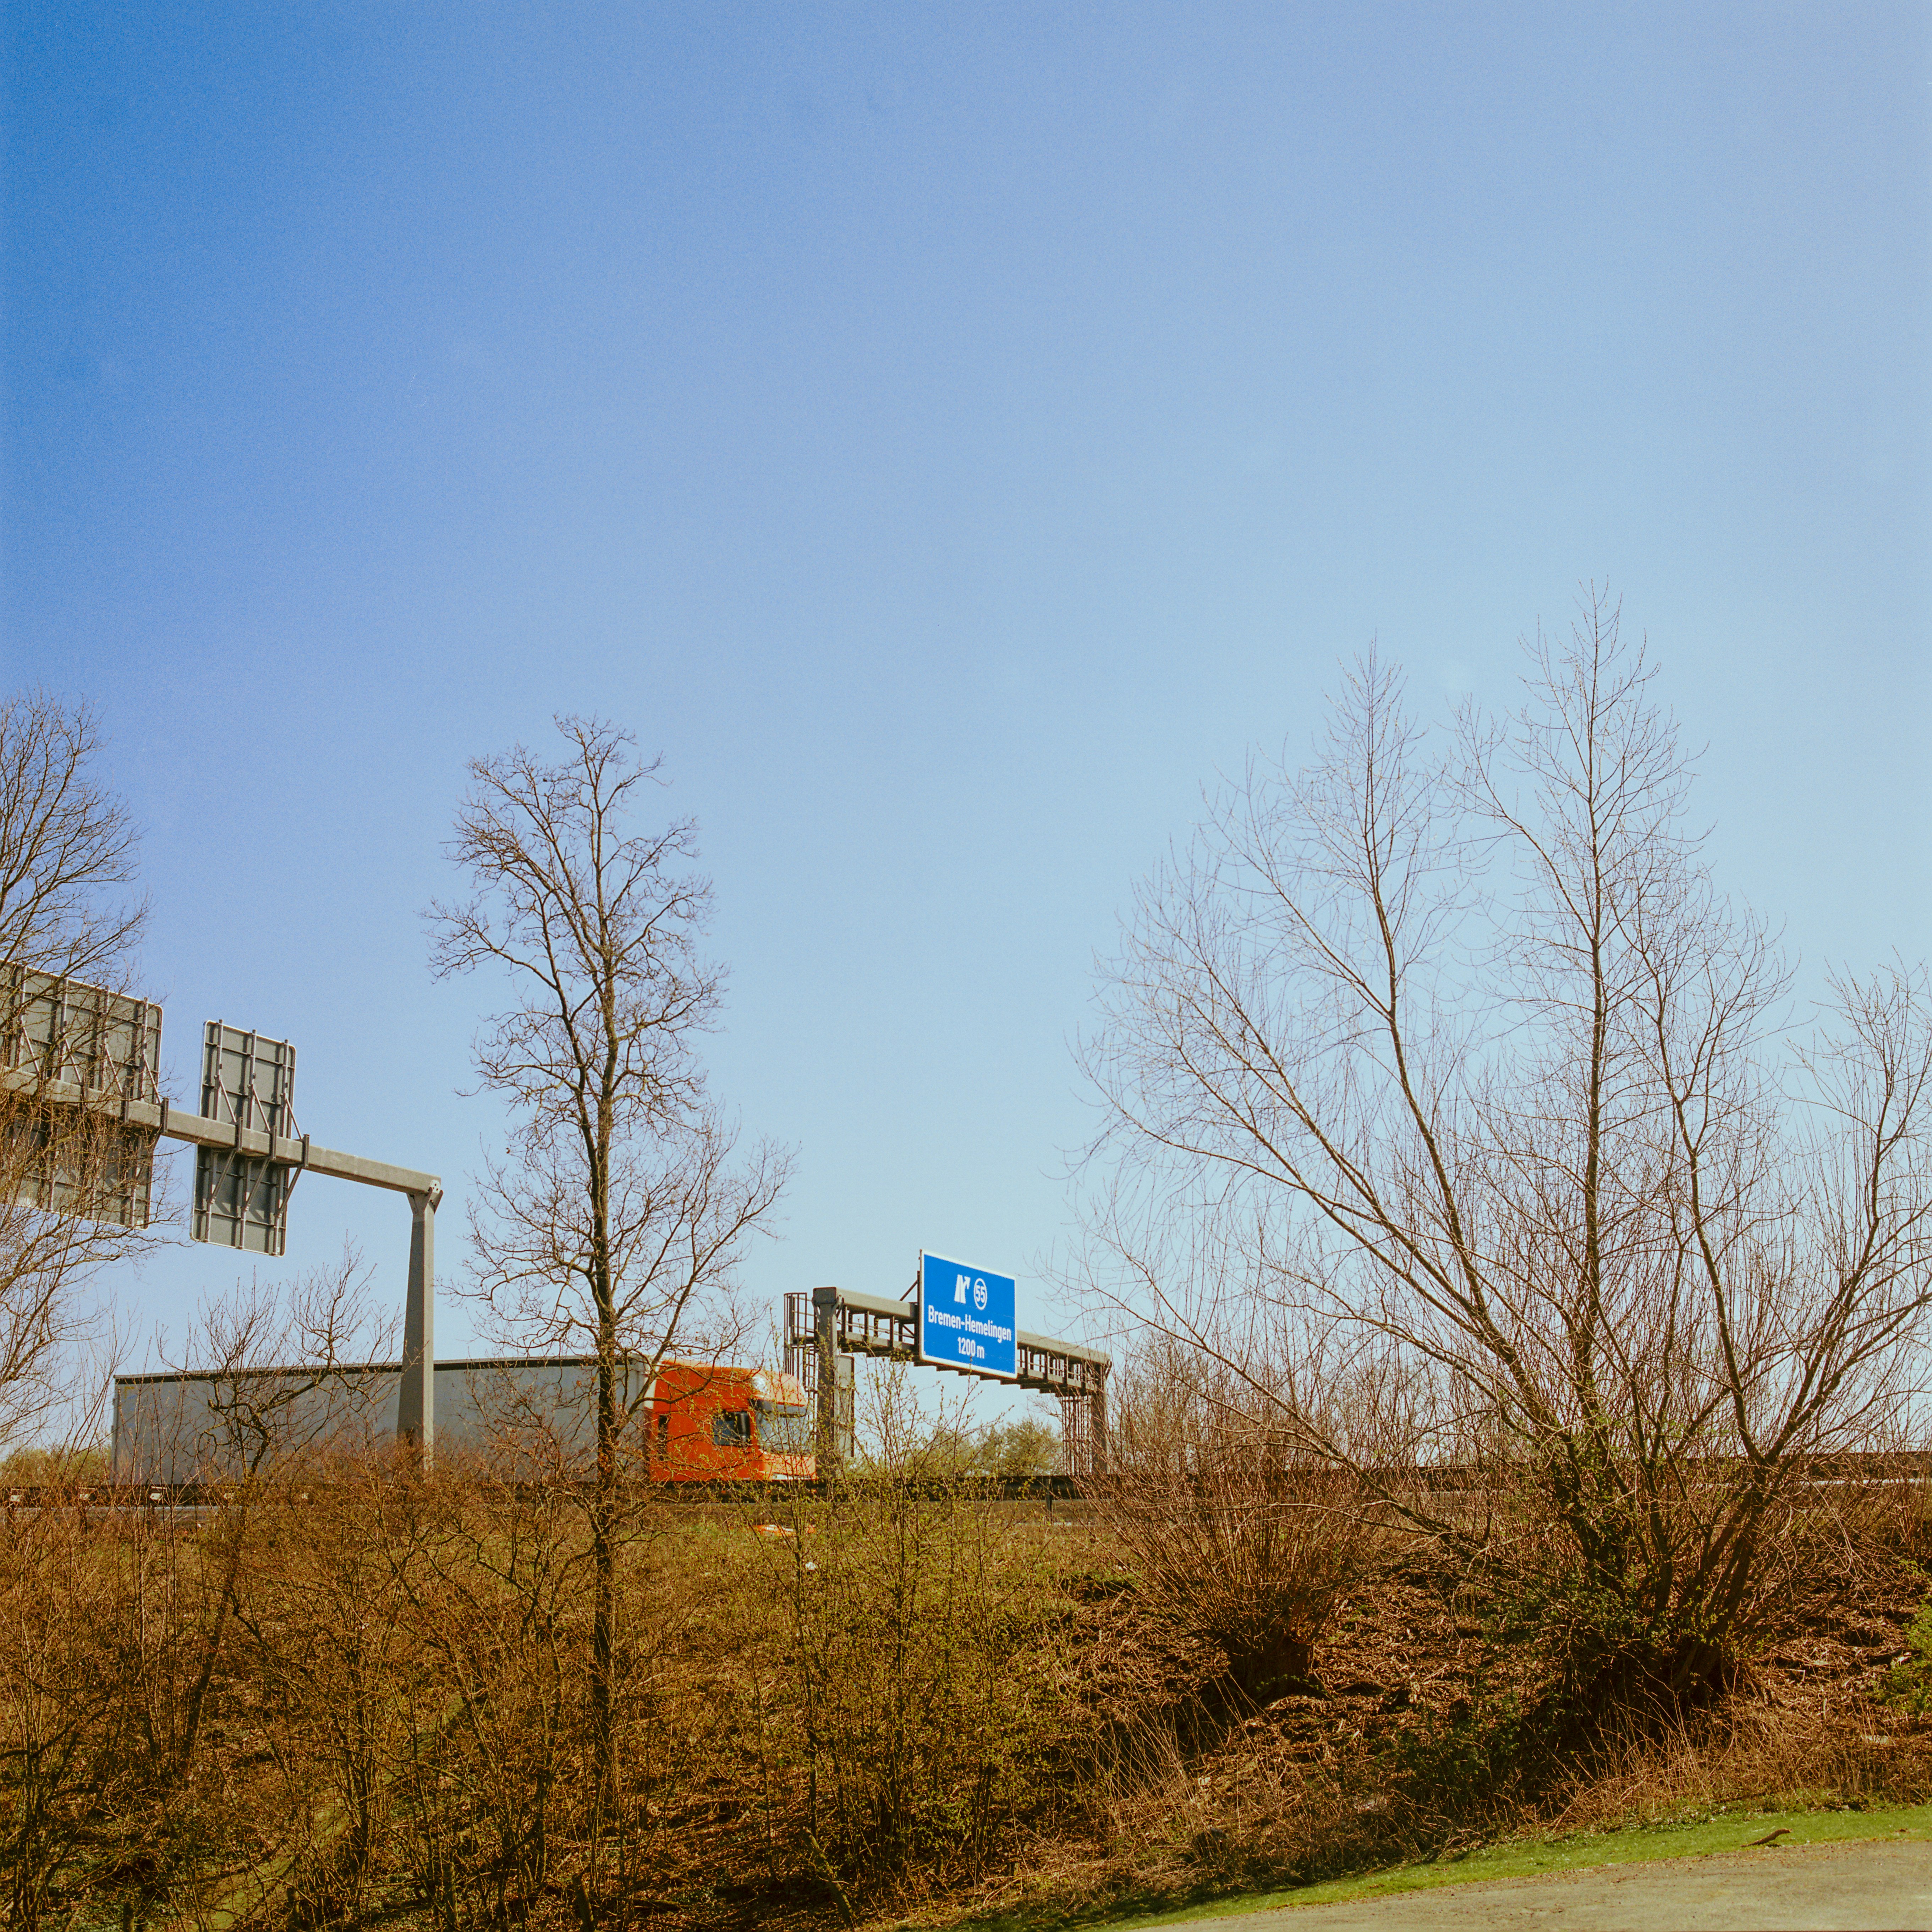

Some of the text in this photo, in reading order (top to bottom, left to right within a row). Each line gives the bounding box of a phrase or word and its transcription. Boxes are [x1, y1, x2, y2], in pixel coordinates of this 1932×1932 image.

[976, 1285, 986, 1303] 55
[928, 1305, 1011, 1343] Bremen-Hemelingen
[957, 1337, 984, 1359] 1200 m
